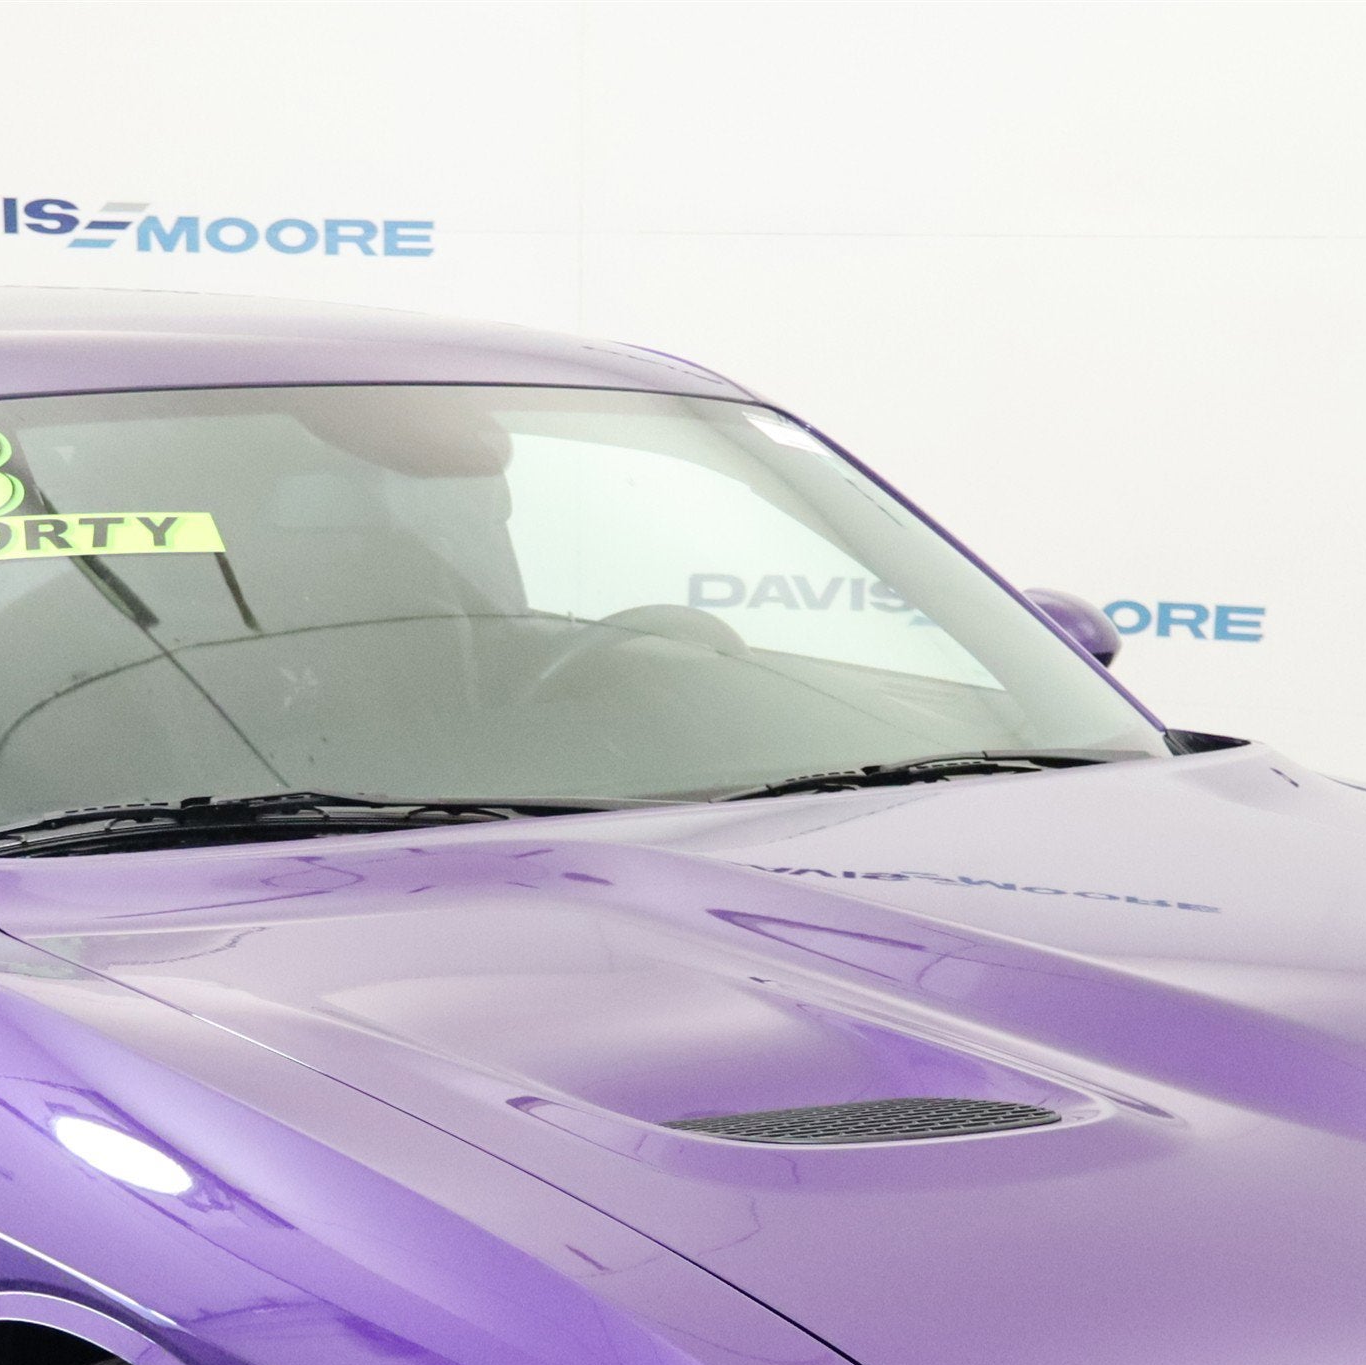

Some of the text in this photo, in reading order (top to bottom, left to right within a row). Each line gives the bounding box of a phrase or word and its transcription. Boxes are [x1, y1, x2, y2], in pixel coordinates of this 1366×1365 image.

[135, 214, 435, 257] MOORE
[688, 572, 1267, 643] DAVIS ORE
